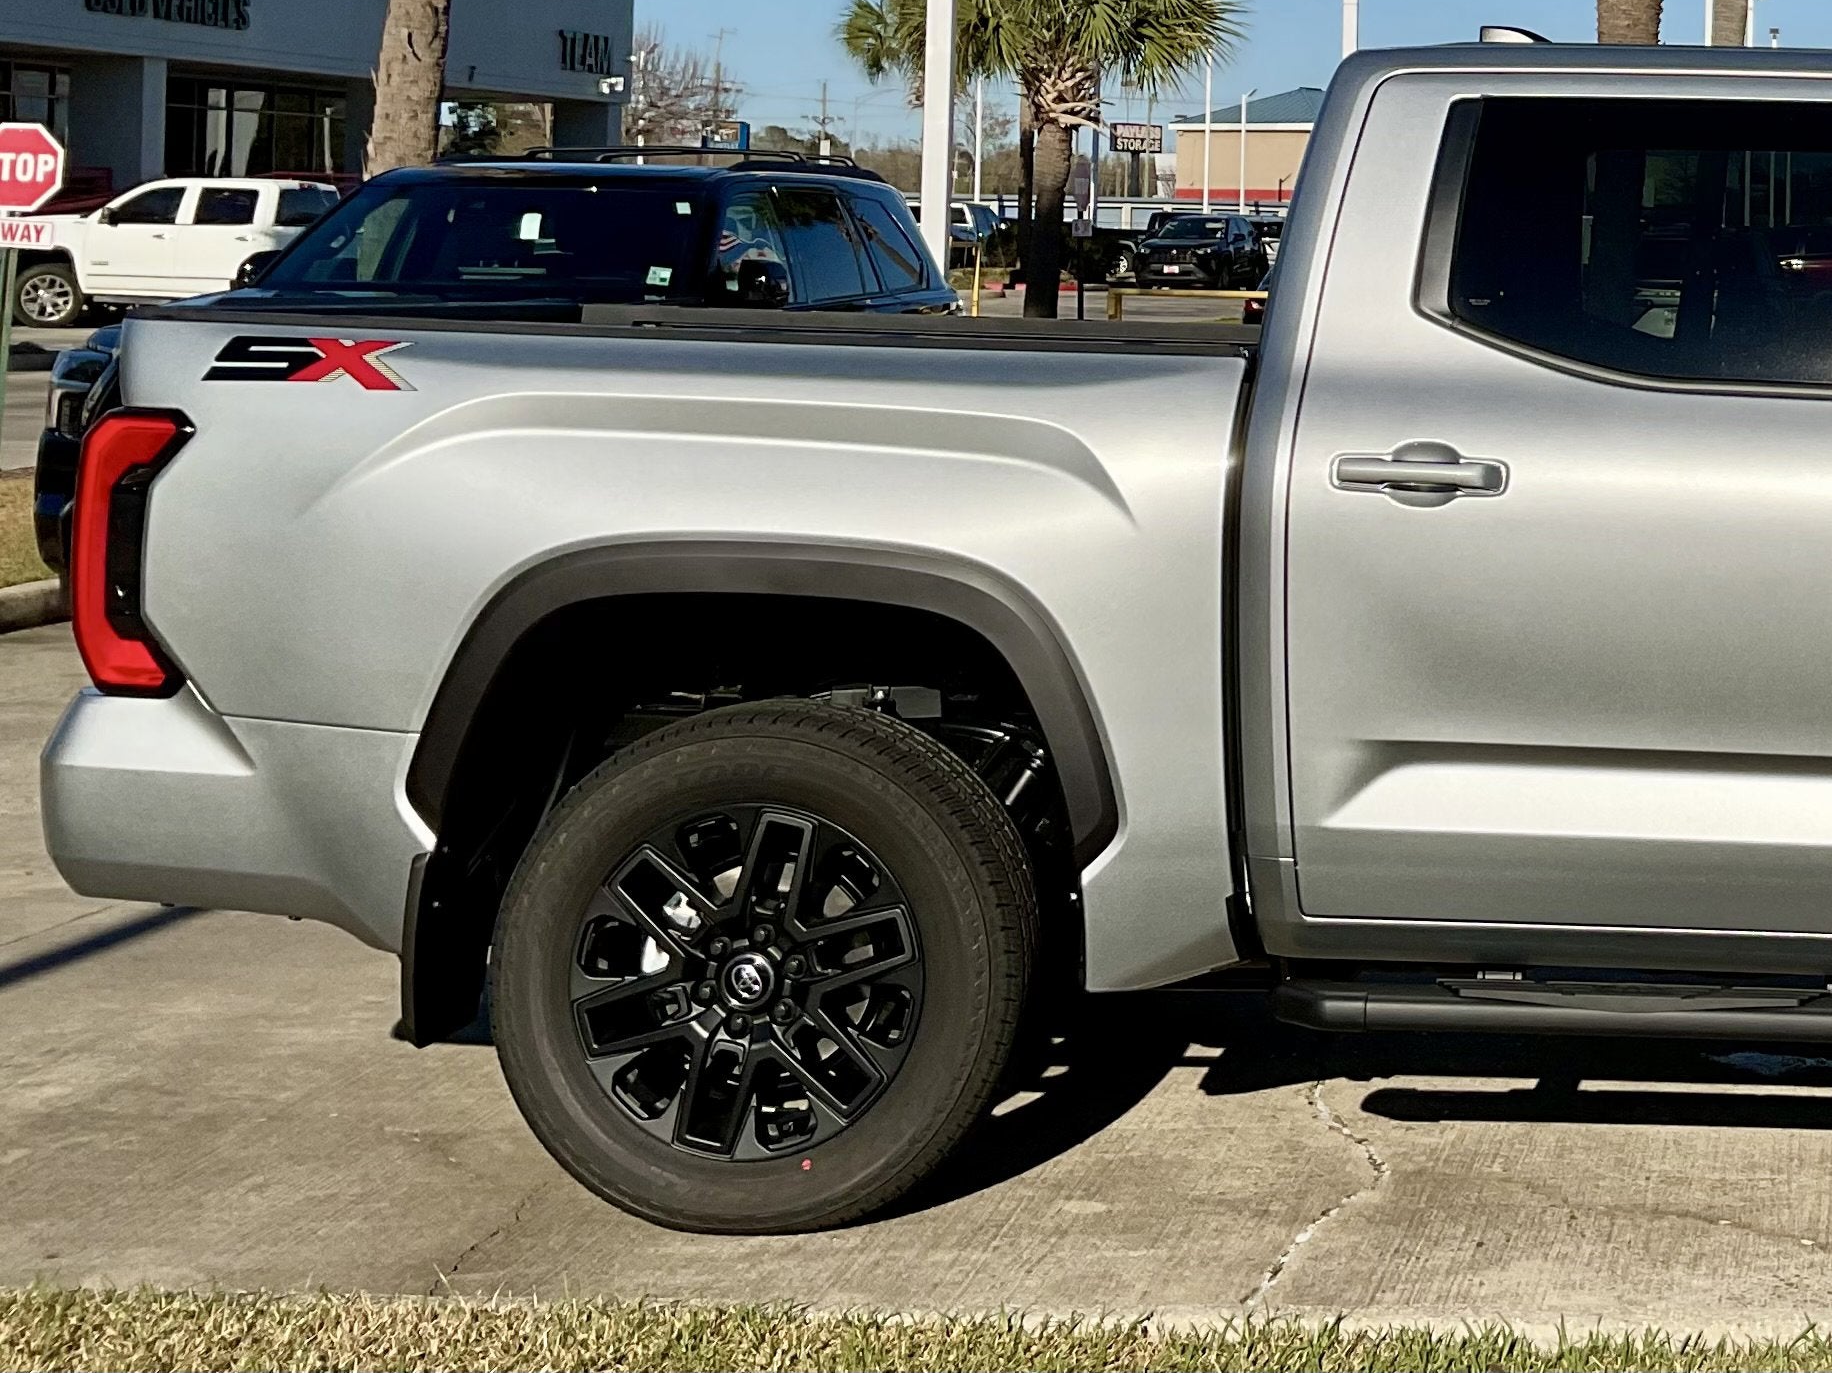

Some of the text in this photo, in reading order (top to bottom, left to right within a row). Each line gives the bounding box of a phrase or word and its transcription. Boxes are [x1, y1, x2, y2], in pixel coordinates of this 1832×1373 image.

[558, 29, 611, 75] TEAM
[1116, 137, 1161, 151] STORAGE
[0, 152, 55, 183] TOP
